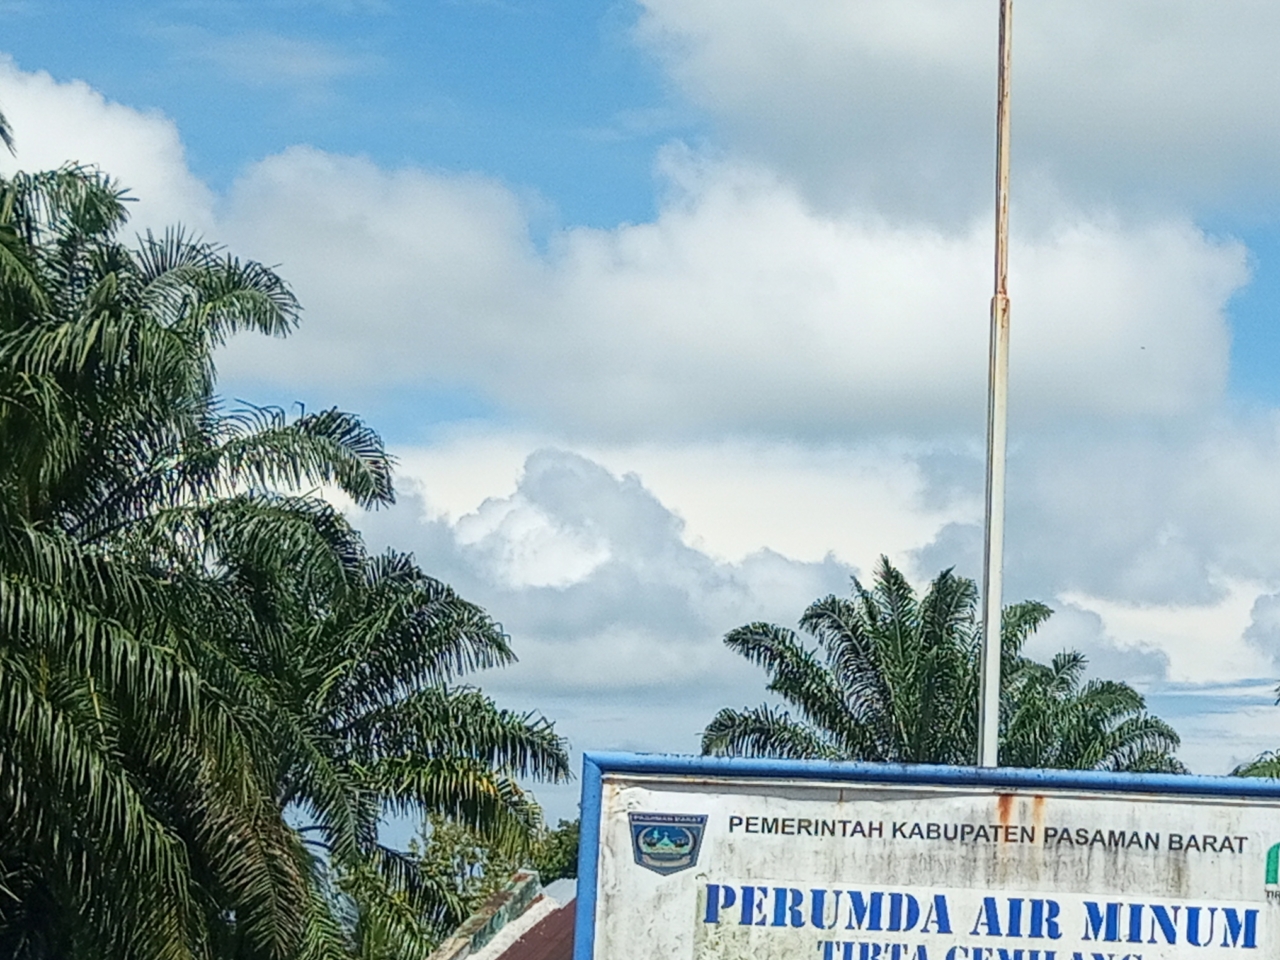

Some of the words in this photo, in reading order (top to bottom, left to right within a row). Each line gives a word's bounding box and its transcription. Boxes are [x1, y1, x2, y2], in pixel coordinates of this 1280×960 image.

[729, 816, 883, 839] PEMERINTAH
[892, 821, 1035, 844] KABUPATEN
[1044, 826, 1160, 850] PASAMAN
[1168, 834, 1248, 853] BARAT
[703, 883, 953, 936] PERUMDA
[969, 896, 1063, 940] AIR
[1082, 901, 1260, 949] MINUM
